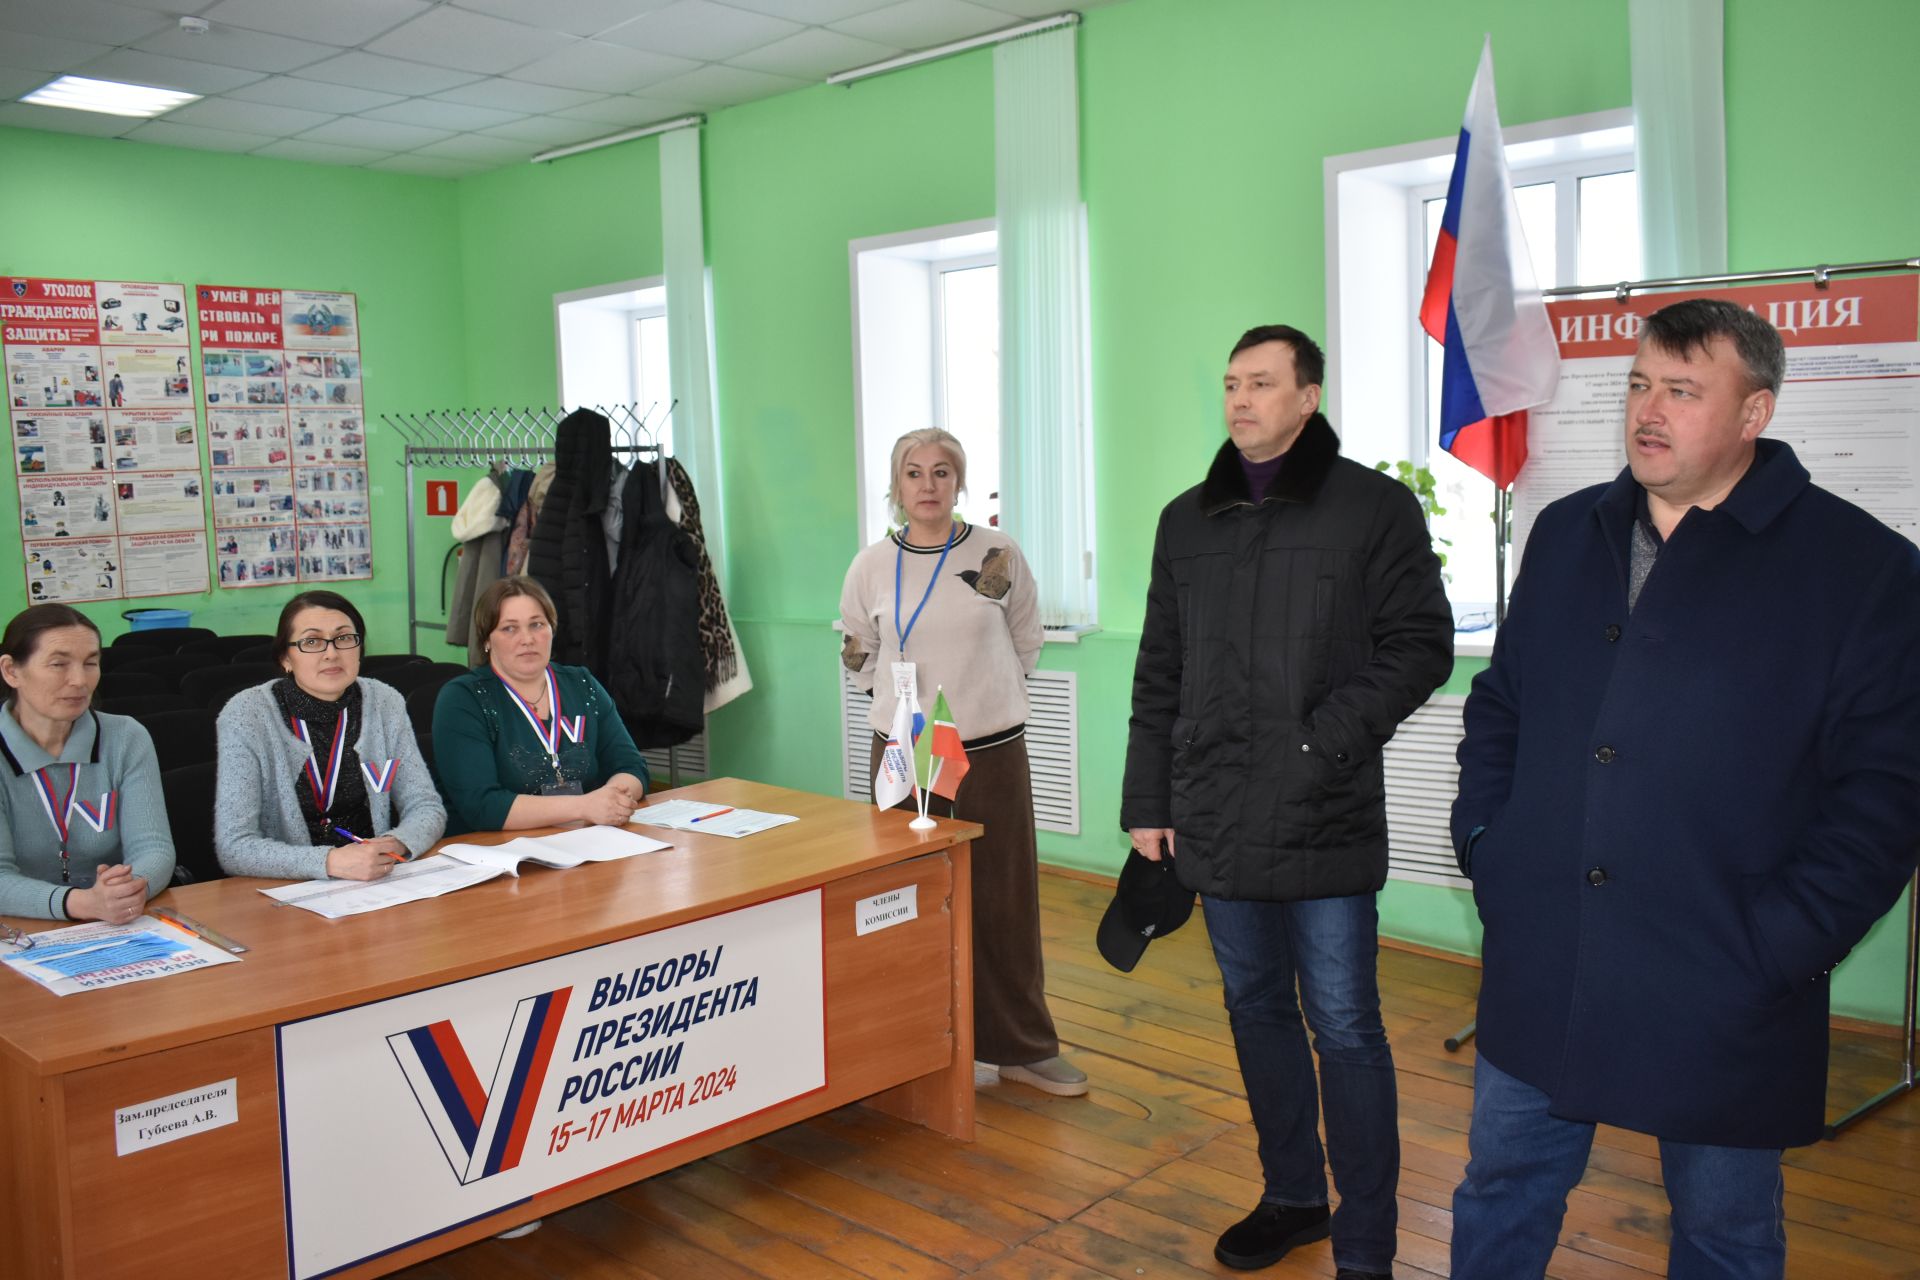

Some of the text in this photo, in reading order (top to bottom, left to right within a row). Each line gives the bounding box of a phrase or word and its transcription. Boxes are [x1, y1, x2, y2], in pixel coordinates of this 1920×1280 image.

[42, 283, 92, 298] УГОЛОК
[211, 289, 280, 306] УМЕЙ ДЕЙ
[0, 304, 97, 320] ГРАЖДАНСКОЙ
[200, 309, 280, 325] СТВОВАТЬ П
[1558, 296, 1863, 343] ИНФЦИЯ
[6, 327, 70, 343] ЗАЩИТЫ
[201, 330, 278, 344] РИ ПОЖАРЕ
[872, 893, 900, 907] ЧЛЕНЫ
[865, 906, 909, 927] КОМИССИИ
[80, 958, 208, 987] ВСЕЙ СЕМЬЕЙ
[587, 945, 724, 1013] ВЫБОРЫ
[572, 976, 759, 1062] ПРЕЗИДЕНТА
[557, 1041, 684, 1113] РОССИИ
[117, 1088, 227, 1124] Зам.председателя
[547, 1064, 737, 1156] 15–17 МАРТА 2024
[139, 1109, 217, 1140] Губеева А.В.
